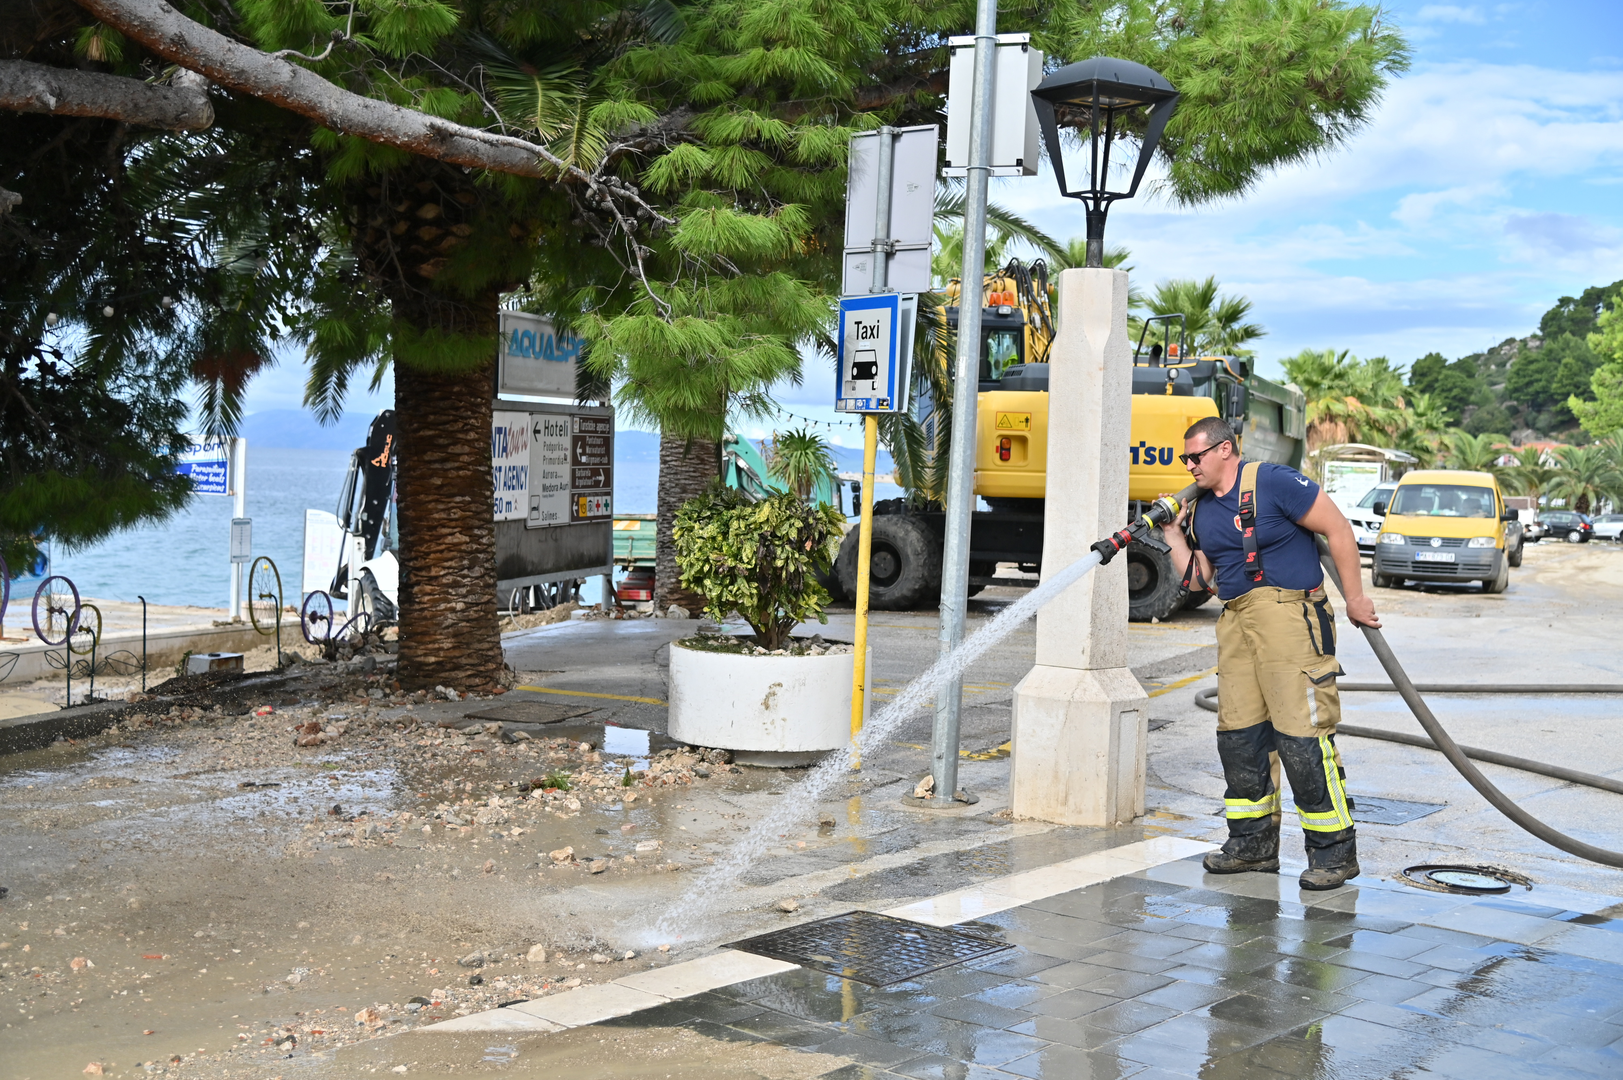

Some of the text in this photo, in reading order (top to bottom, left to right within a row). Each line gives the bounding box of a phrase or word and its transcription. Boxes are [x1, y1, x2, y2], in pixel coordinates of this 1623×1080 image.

[854, 319, 880, 341] Taxi
[543, 420, 569, 438] Hoteli
[503, 465, 529, 491] AGENCY
[542, 469, 558, 480] Aurora
[542, 483, 558, 492] Medora
[505, 500, 512, 513] m
